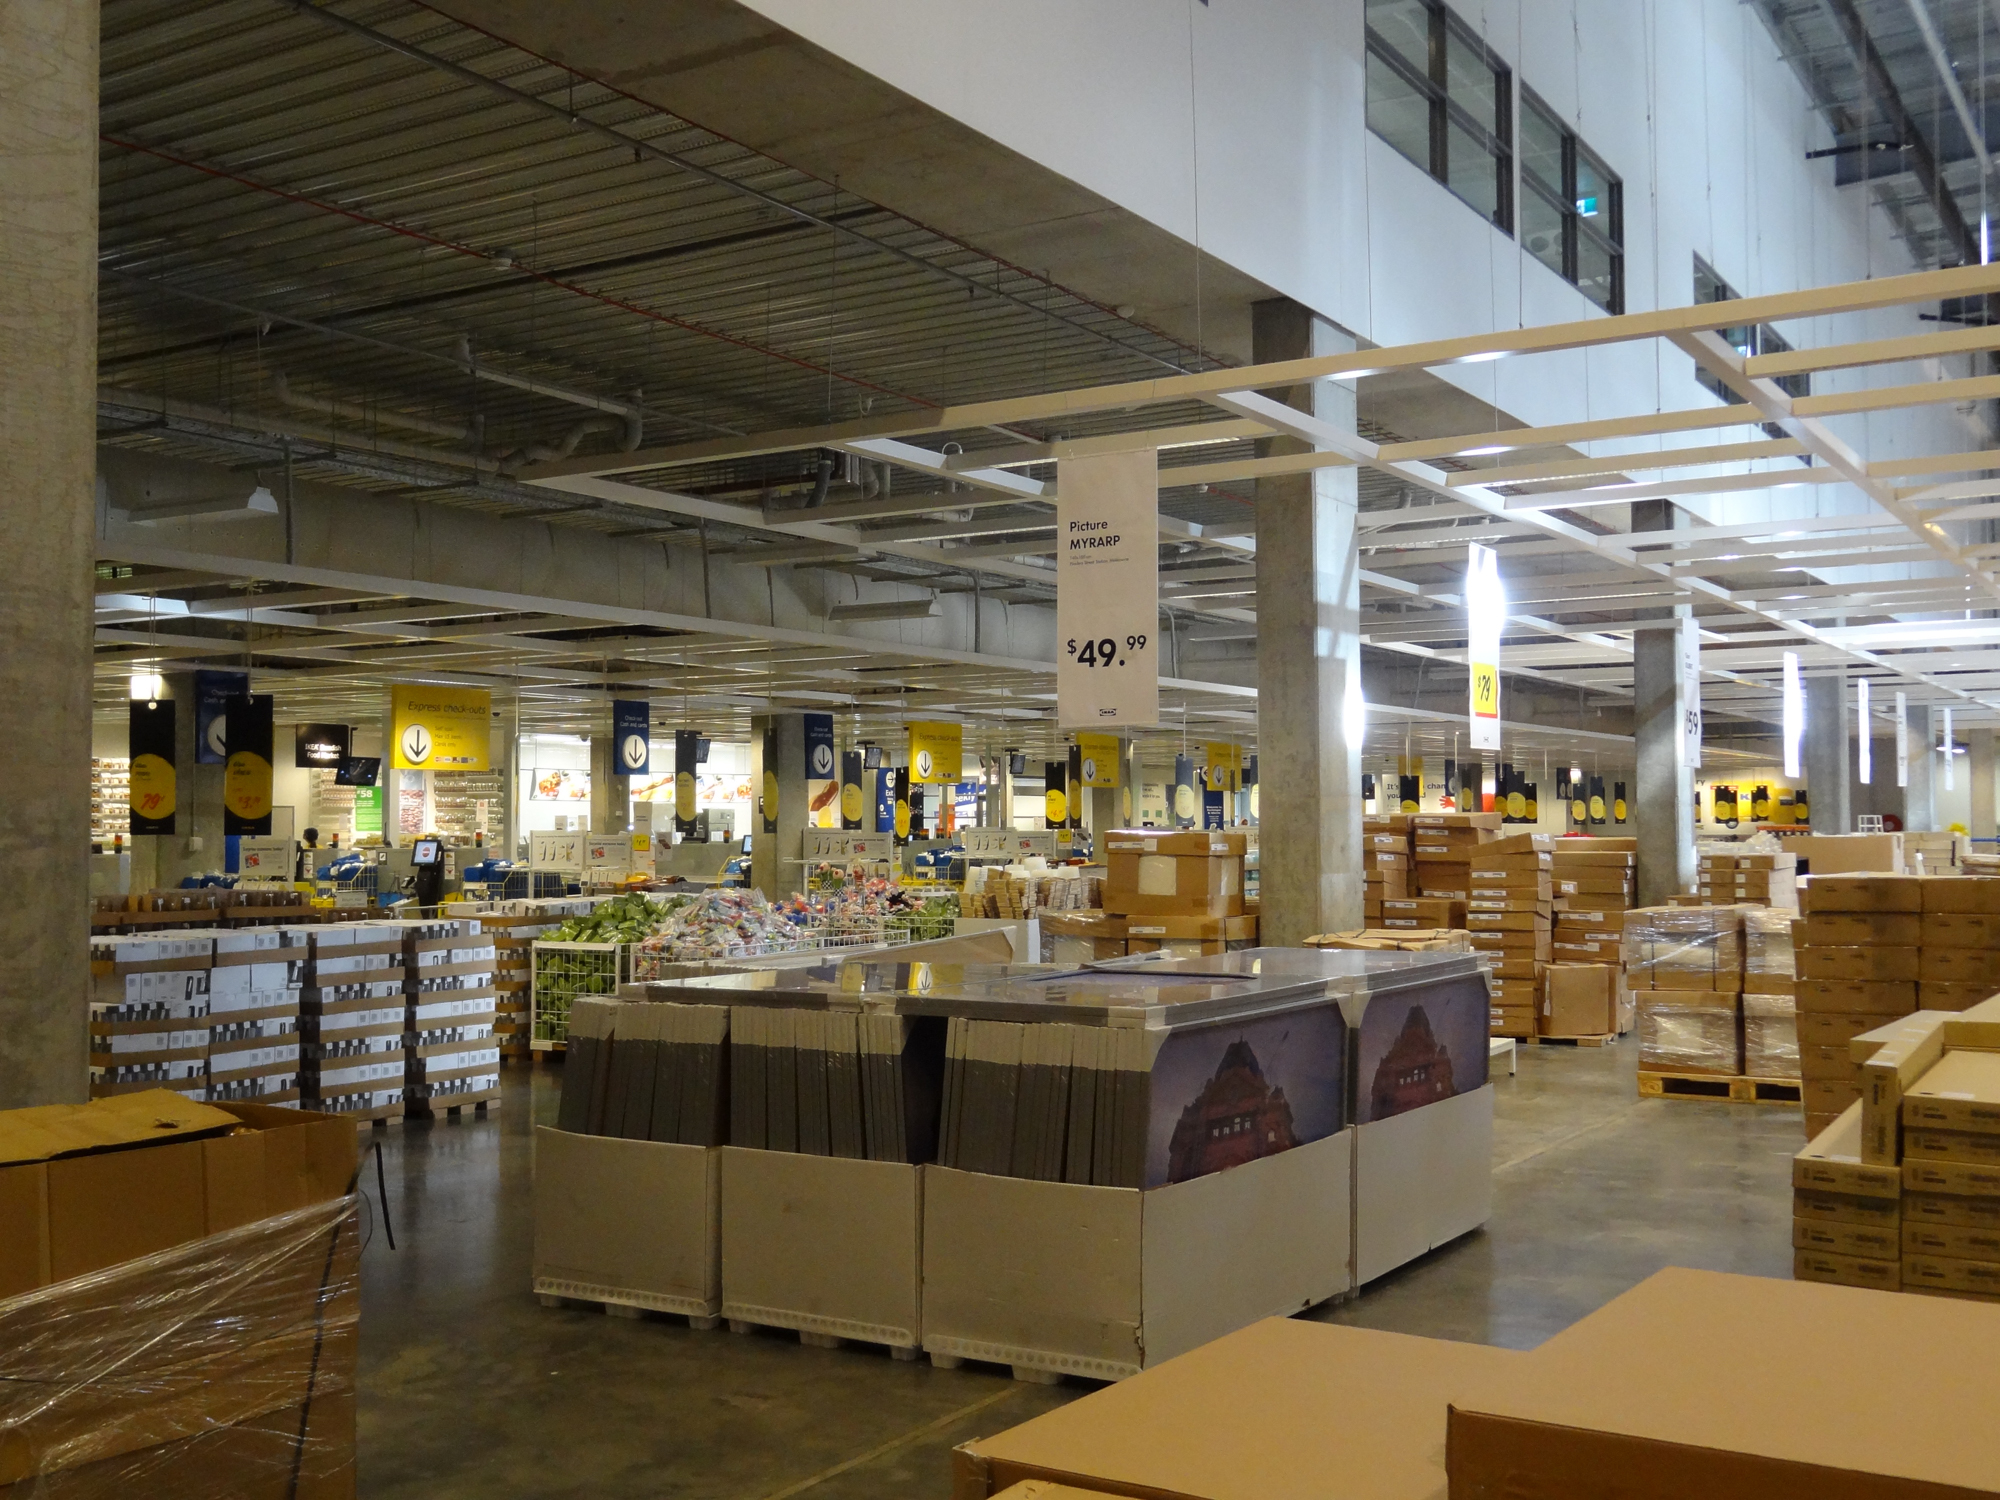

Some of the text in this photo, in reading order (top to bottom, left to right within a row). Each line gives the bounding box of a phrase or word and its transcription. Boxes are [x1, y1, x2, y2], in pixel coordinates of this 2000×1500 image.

[1070, 521, 1108, 532] Picture
[1070, 535, 1121, 550] MYRARP
[1478, 674, 1491, 702] $79
[408, 701, 486, 714] Express check-outs
